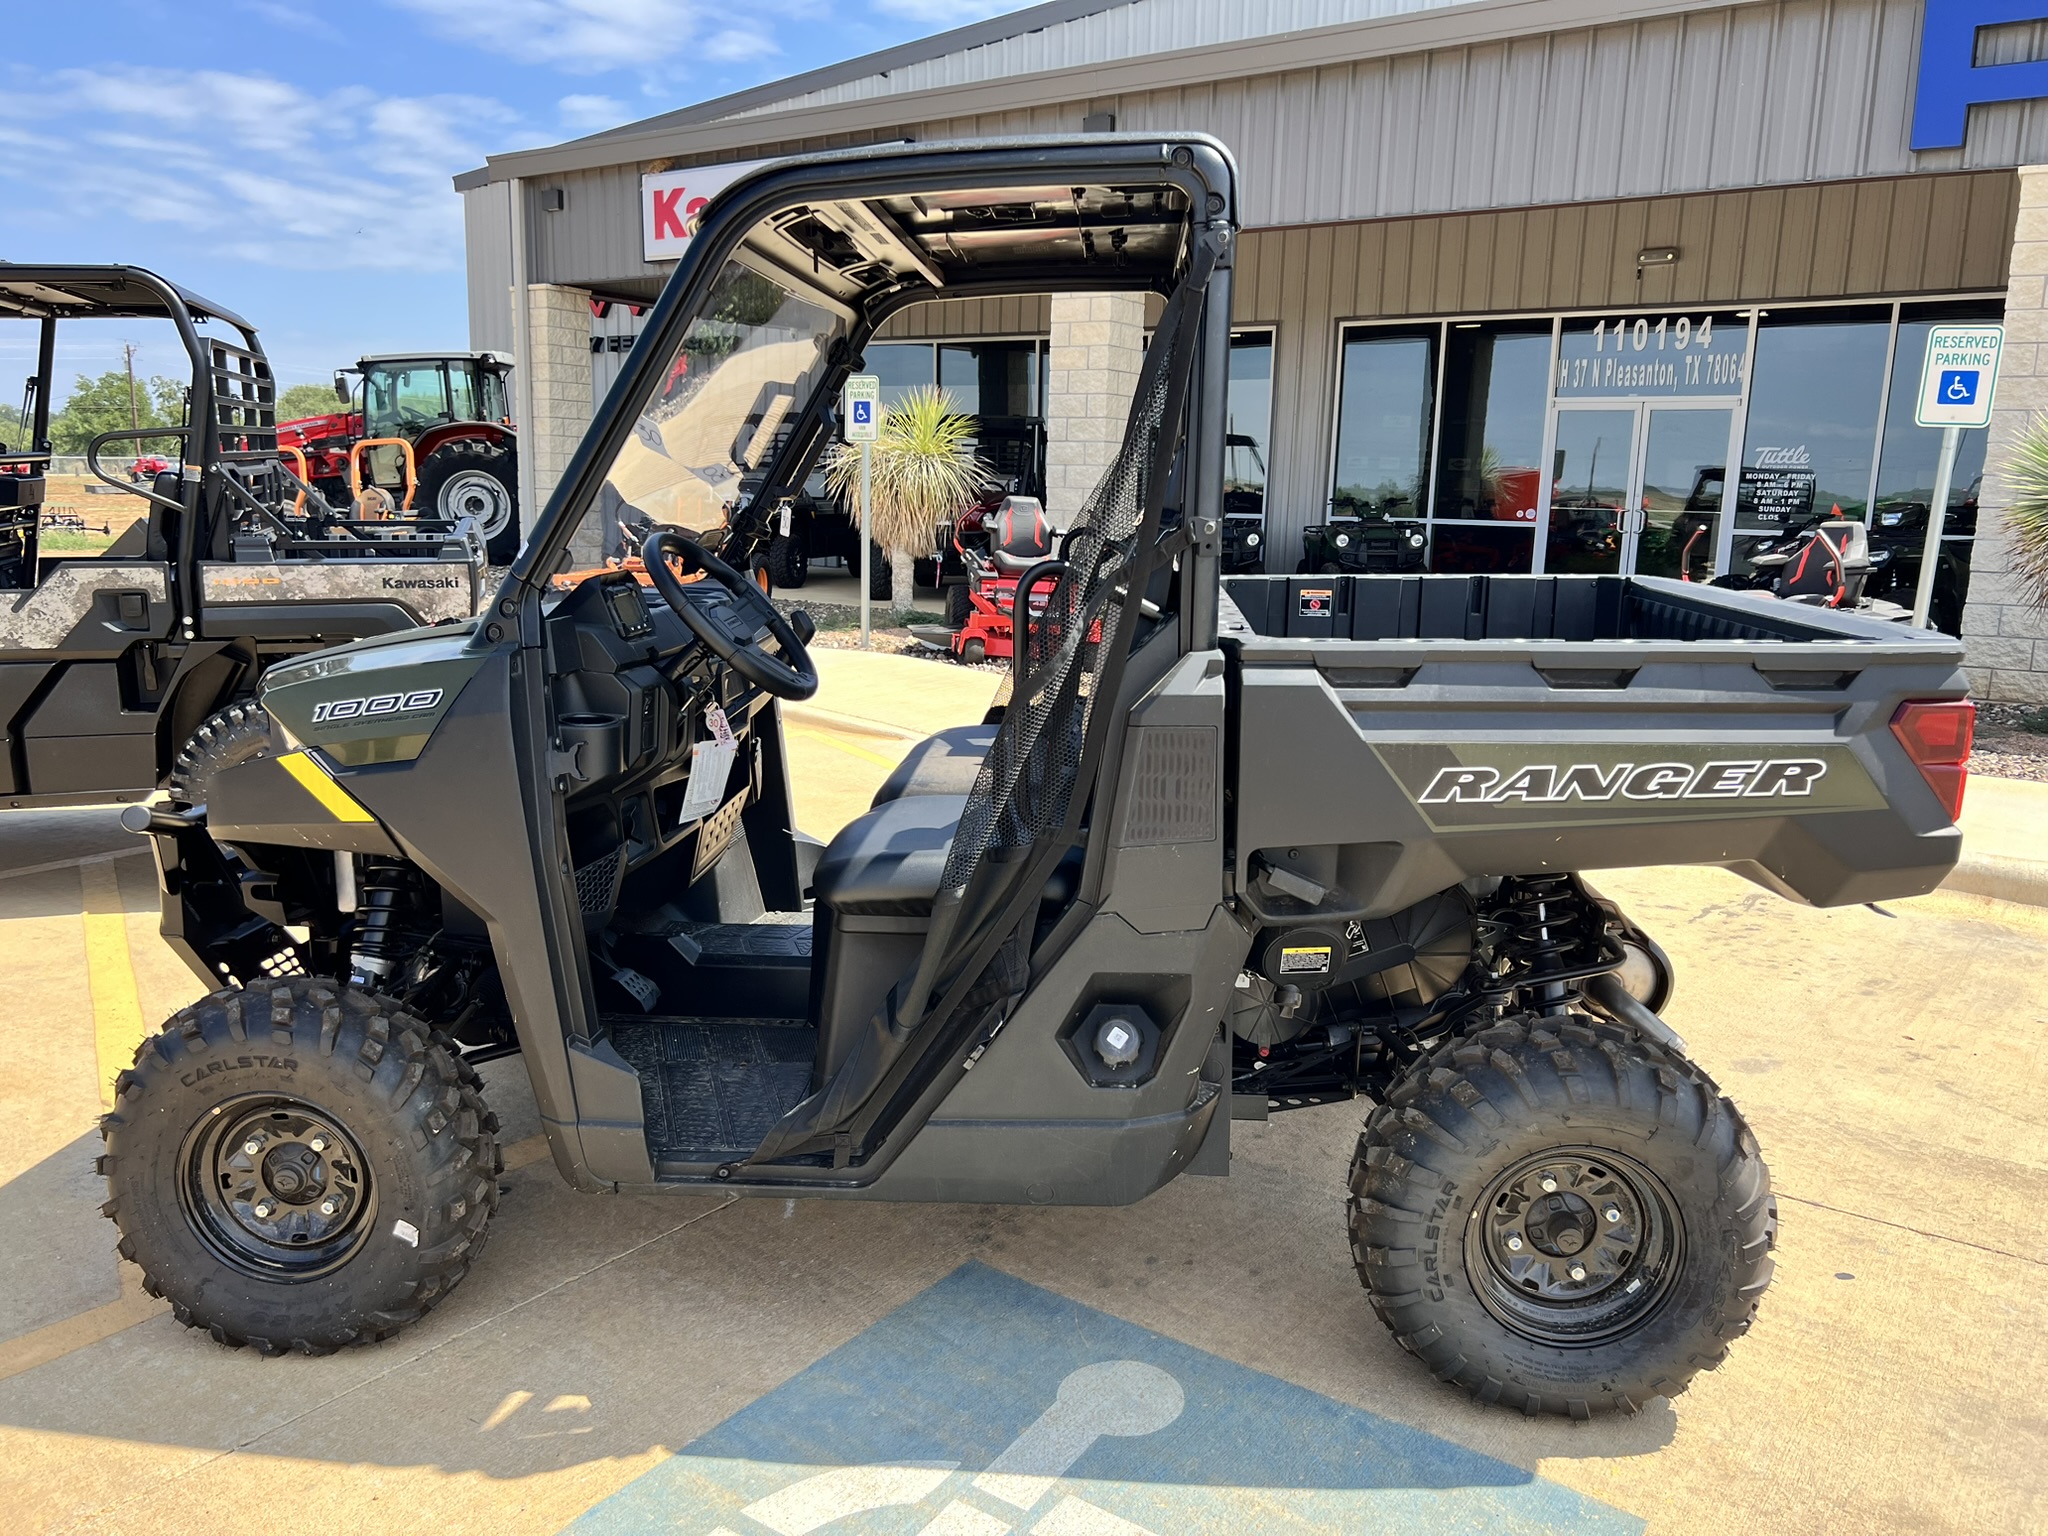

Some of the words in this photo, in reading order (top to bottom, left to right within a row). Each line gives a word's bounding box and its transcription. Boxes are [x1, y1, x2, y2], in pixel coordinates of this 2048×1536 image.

[1593, 316, 1713, 352] 110194
[1934, 336, 1998, 349] RESERVED
[1935, 353, 1991, 366] PARKING
[1573, 358, 1588, 388] 37
[1591, 359, 1601, 388] N
[1604, 357, 1679, 393] Pleasanton,
[1685, 355, 1702, 385] TX
[1706, 352, 1746, 385] 78064
[847, 381, 876, 390] RESERVED
[849, 390, 875, 400] PARKING
[1755, 445, 1811, 469] Tuttle
[1745, 472, 1780, 480] MONDAY
[1786, 473, 1817, 481] FRIDAY
[1763, 481, 1776, 489] AM
[1756, 489, 1800, 497] SATURDAY
[382, 576, 460, 590] Kawasaki
[311, 688, 443, 723] 1000
[313, 722, 349, 732] SINGLE
[353, 715, 409, 727] OVERHEAD
[410, 711, 436, 720] CAM
[708, 718, 719, 728] 30
[1417, 758, 1828, 804] RANGER
[180, 1055, 299, 1088] CARLSTAR
[1424, 1181, 1459, 1303] CARLSTAR
